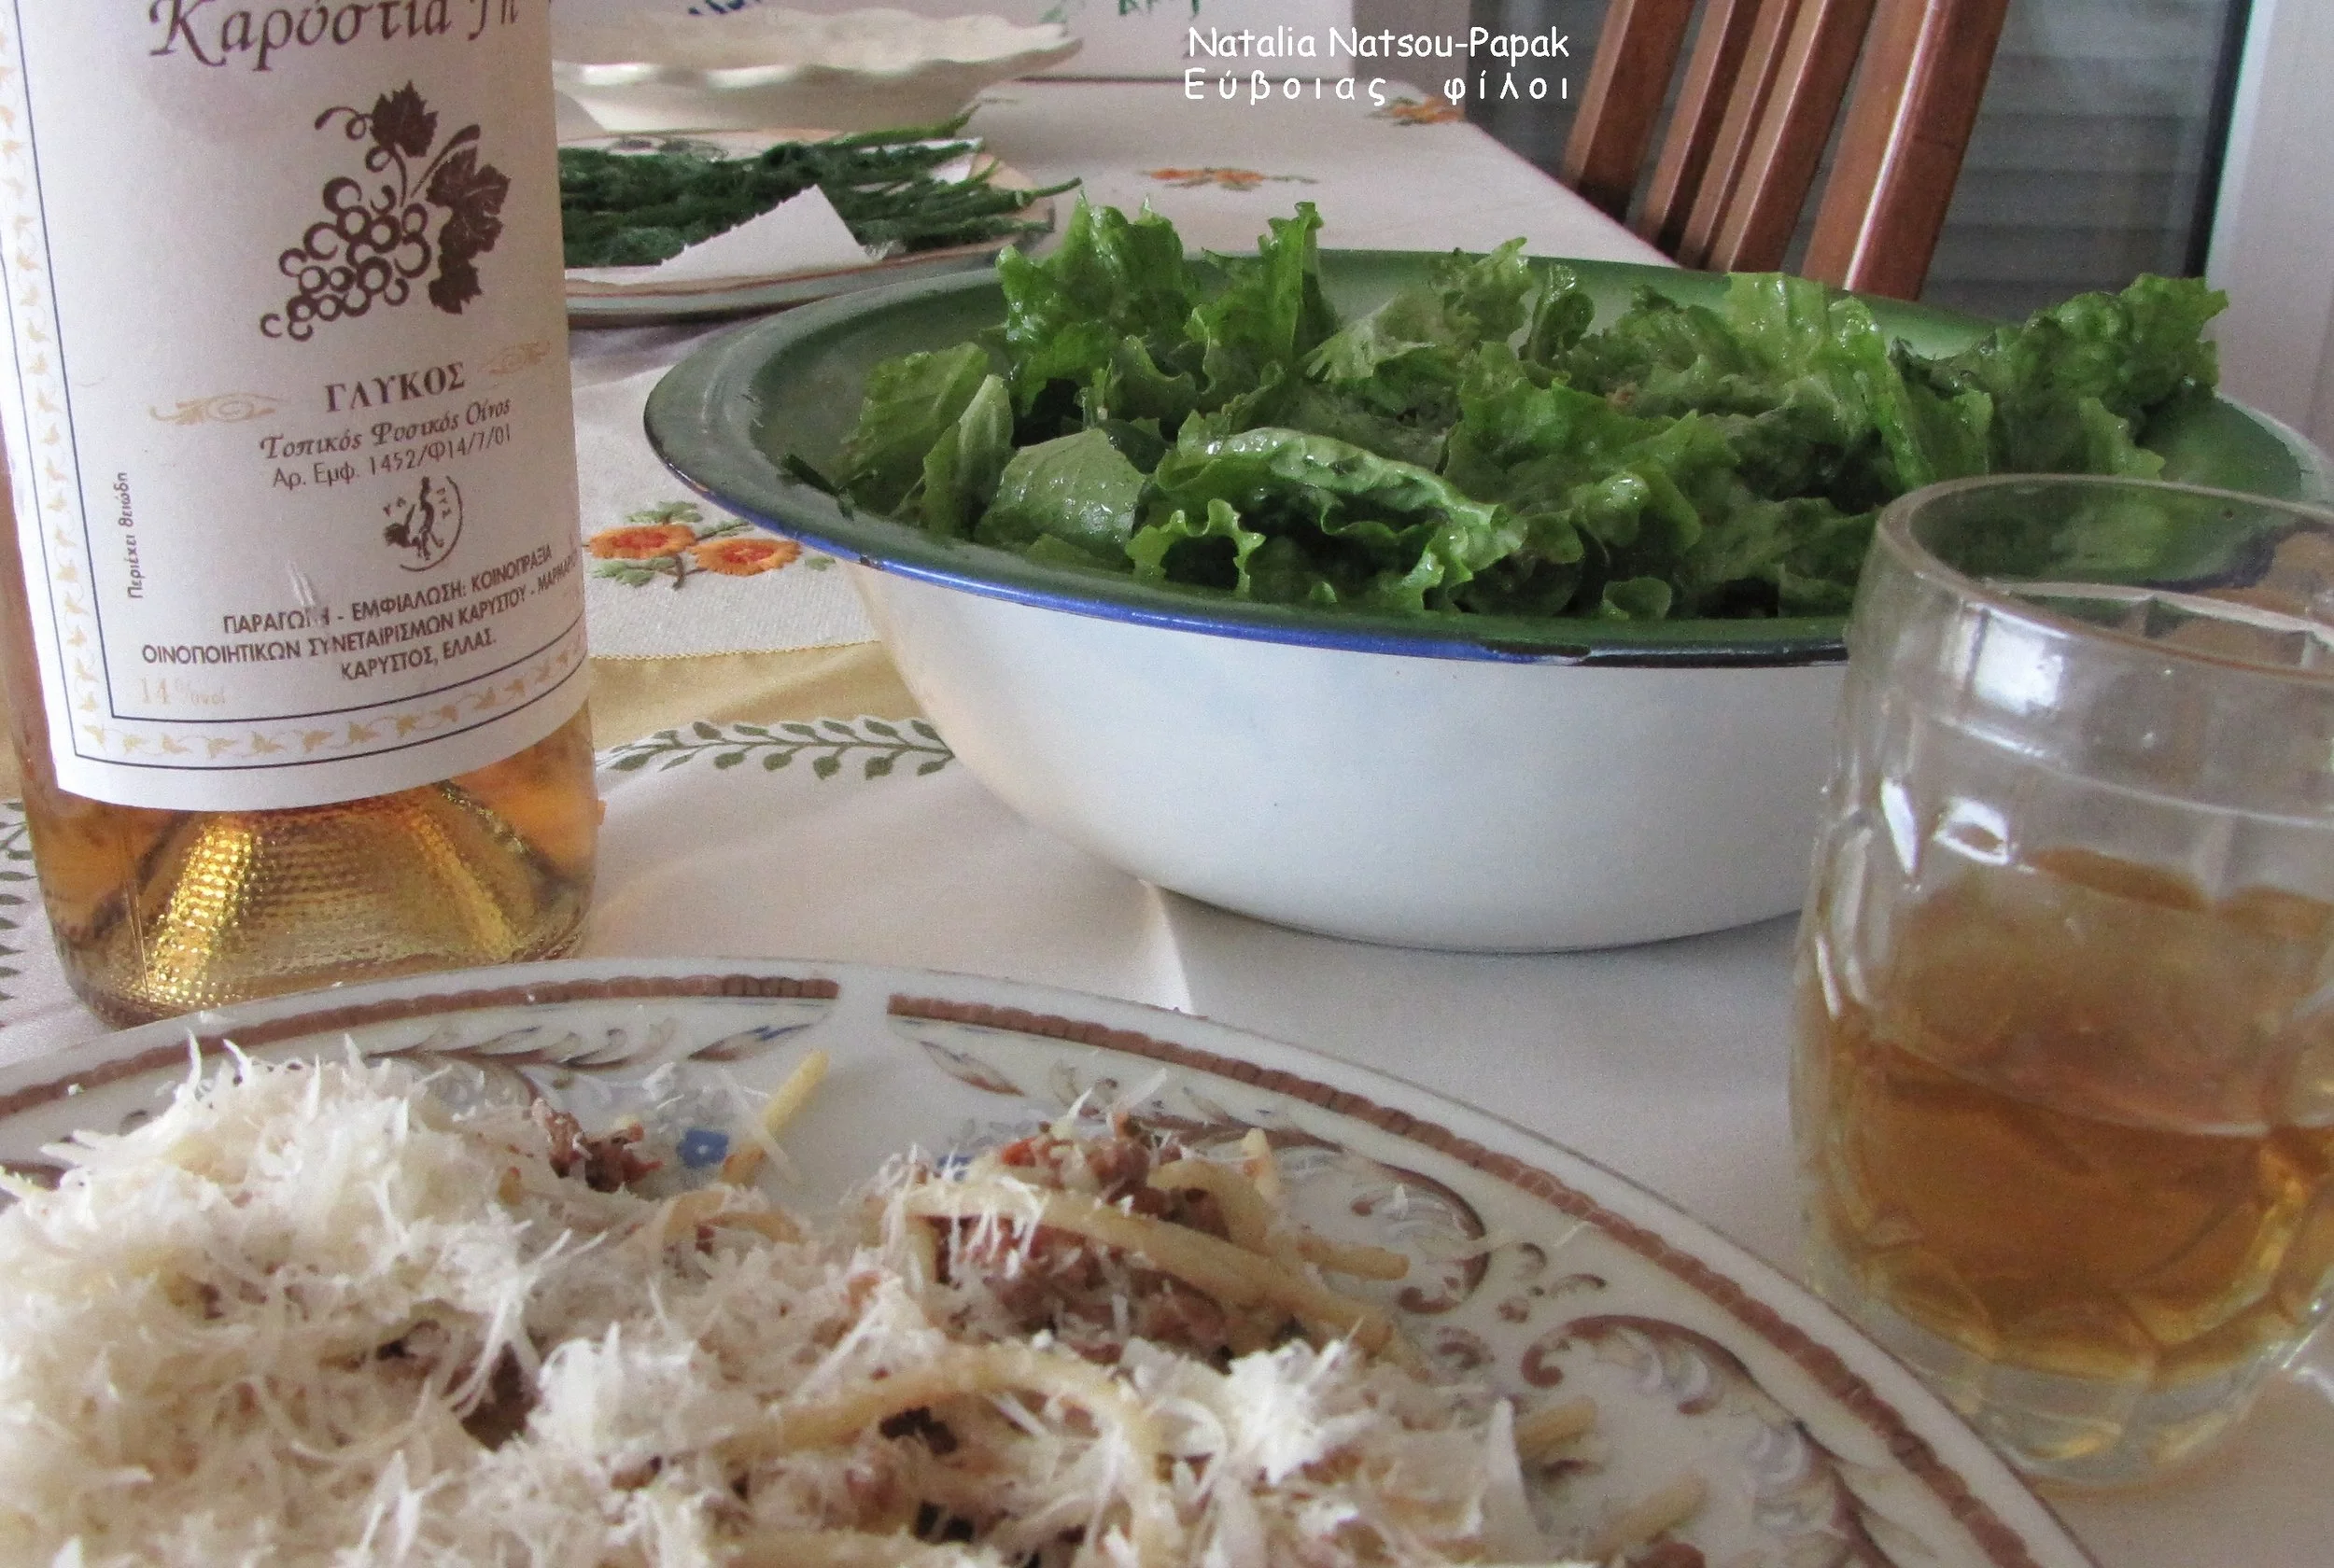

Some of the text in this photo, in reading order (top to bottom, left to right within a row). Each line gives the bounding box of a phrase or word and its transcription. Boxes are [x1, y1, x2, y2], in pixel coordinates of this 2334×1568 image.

[324, 361, 465, 413] ΓΛΥΚΟΣ
[260, 429, 362, 458] Τοπικός
[467, 399, 512, 425] Οίνος
[273, 467, 306, 490] Αρ.
[313, 461, 360, 486] Εμφ.
[113, 472, 145, 598] Περιέχει θειώδη
[352, 581, 466, 621] ΕΜΦΙΑΛΩΣΗ:
[471, 543, 552, 593] ΚΟΙΝΟΠΡΑΞΙΑ
[142, 639, 301, 665] ΟΙΝΟΠΟΙΗΤΙΚΩΝ
[308, 612, 454, 657] ΣΥΝΕΤΑΙΡΙΣΜΩΝ
[458, 584, 526, 624] ΚΑΡΥΣΤΟΥ
[342, 627, 497, 681] ΚΑΡΥΣΤΟΣ, ΕΛΛΑΣ.
